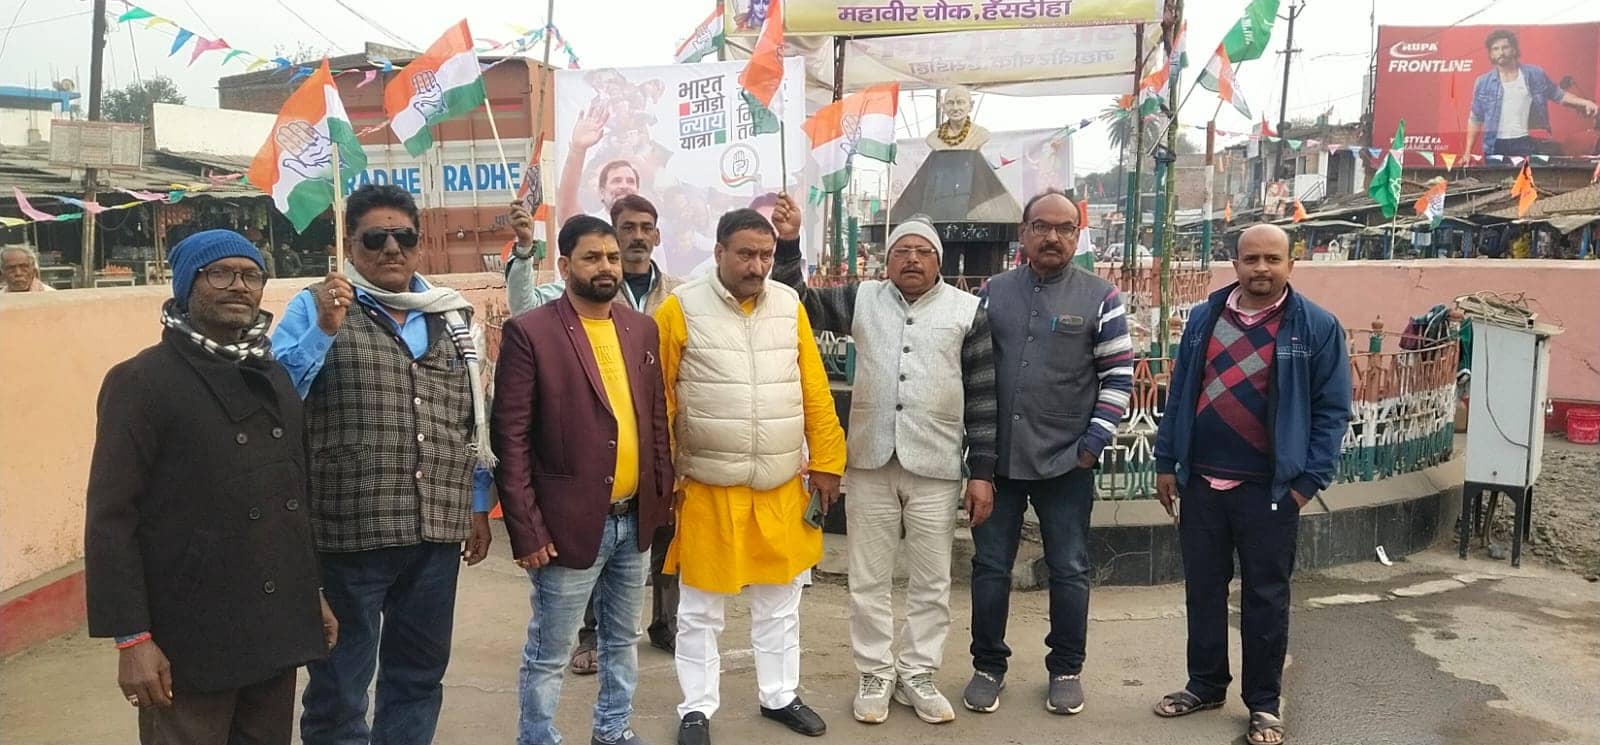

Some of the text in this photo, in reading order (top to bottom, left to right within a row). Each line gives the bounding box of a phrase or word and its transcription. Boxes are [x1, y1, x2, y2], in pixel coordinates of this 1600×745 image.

[837, 0, 920, 22] महावीर
[1388, 60, 1473, 72] FRONTLINE
[678, 75, 725, 100] भारत
[680, 112, 725, 136] न्याय
[679, 132, 712, 150] यात्रा
[1403, 135, 1431, 144] STYLE
[444, 163, 520, 191] RADHE
